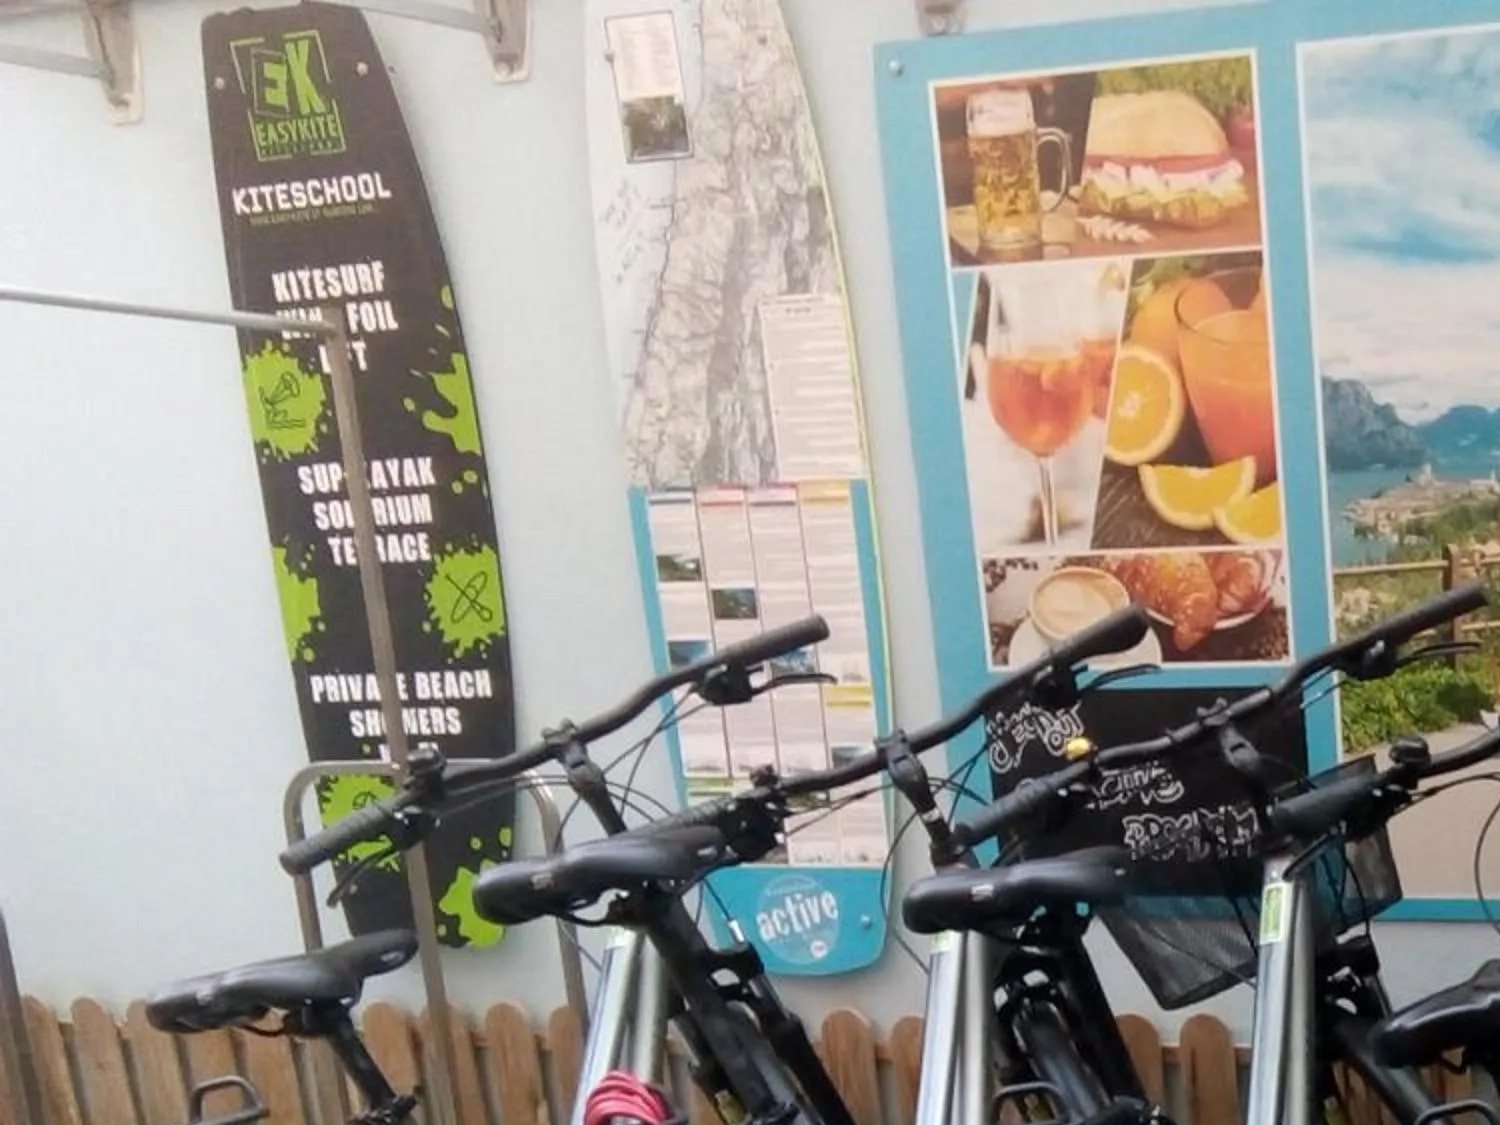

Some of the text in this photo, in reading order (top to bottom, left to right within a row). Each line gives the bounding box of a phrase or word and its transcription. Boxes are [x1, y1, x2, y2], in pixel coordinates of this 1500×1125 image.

[254, 113, 338, 147] EASYKITE
[231, 171, 393, 216] KITESCHOOL
[271, 259, 385, 303] KITESURF
[345, 299, 399, 334] FOIL
[297, 456, 437, 495] SUP AYAK
[313, 493, 433, 531] SOLRIUM
[309, 668, 493, 703] PRIVAE BEACH
[755, 889, 839, 942] active
